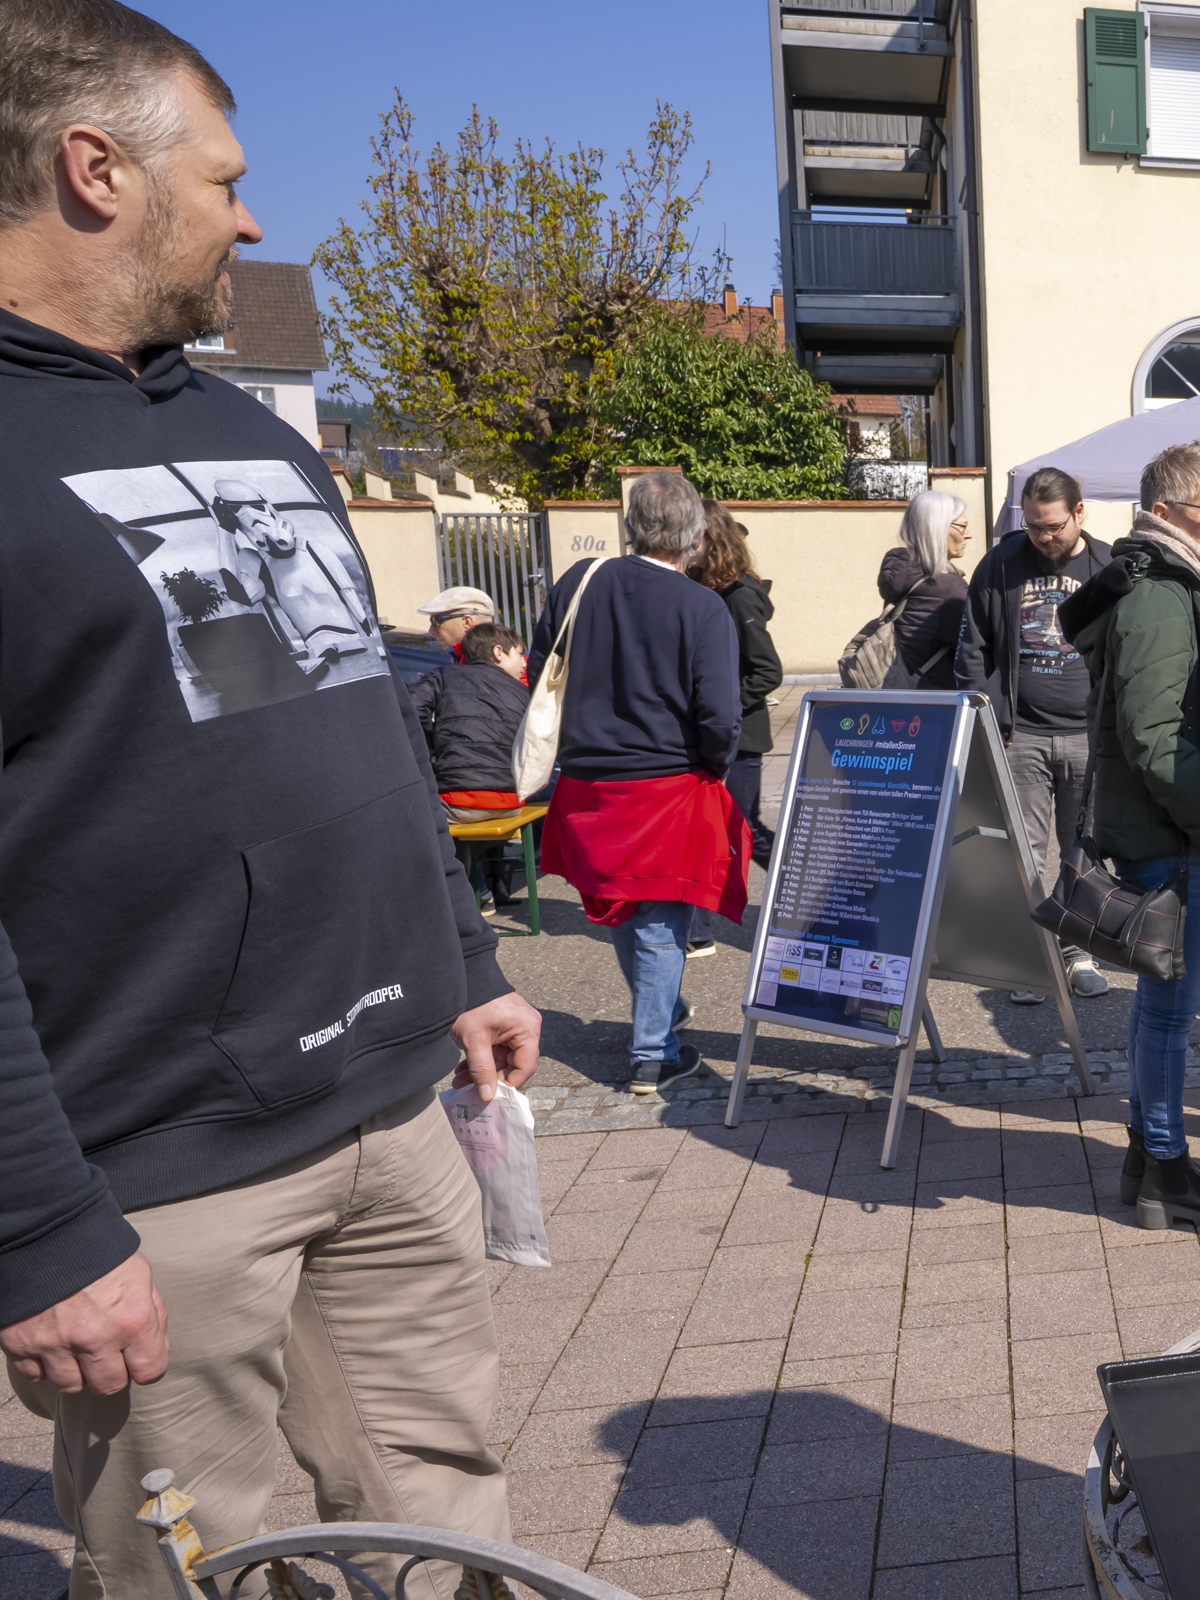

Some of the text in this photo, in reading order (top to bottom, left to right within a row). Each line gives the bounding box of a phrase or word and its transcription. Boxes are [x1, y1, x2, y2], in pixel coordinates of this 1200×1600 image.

[571, 535, 606, 552] 80a
[1032, 666, 1062, 676] ORLANDO
[835, 739, 916, 750] LAUCHRINGEN #mitallenSinnen
[831, 750, 914, 774] Gewinnspiel
[786, 944, 802, 956] ASS
[300, 1020, 345, 1052] ORIGINAL
